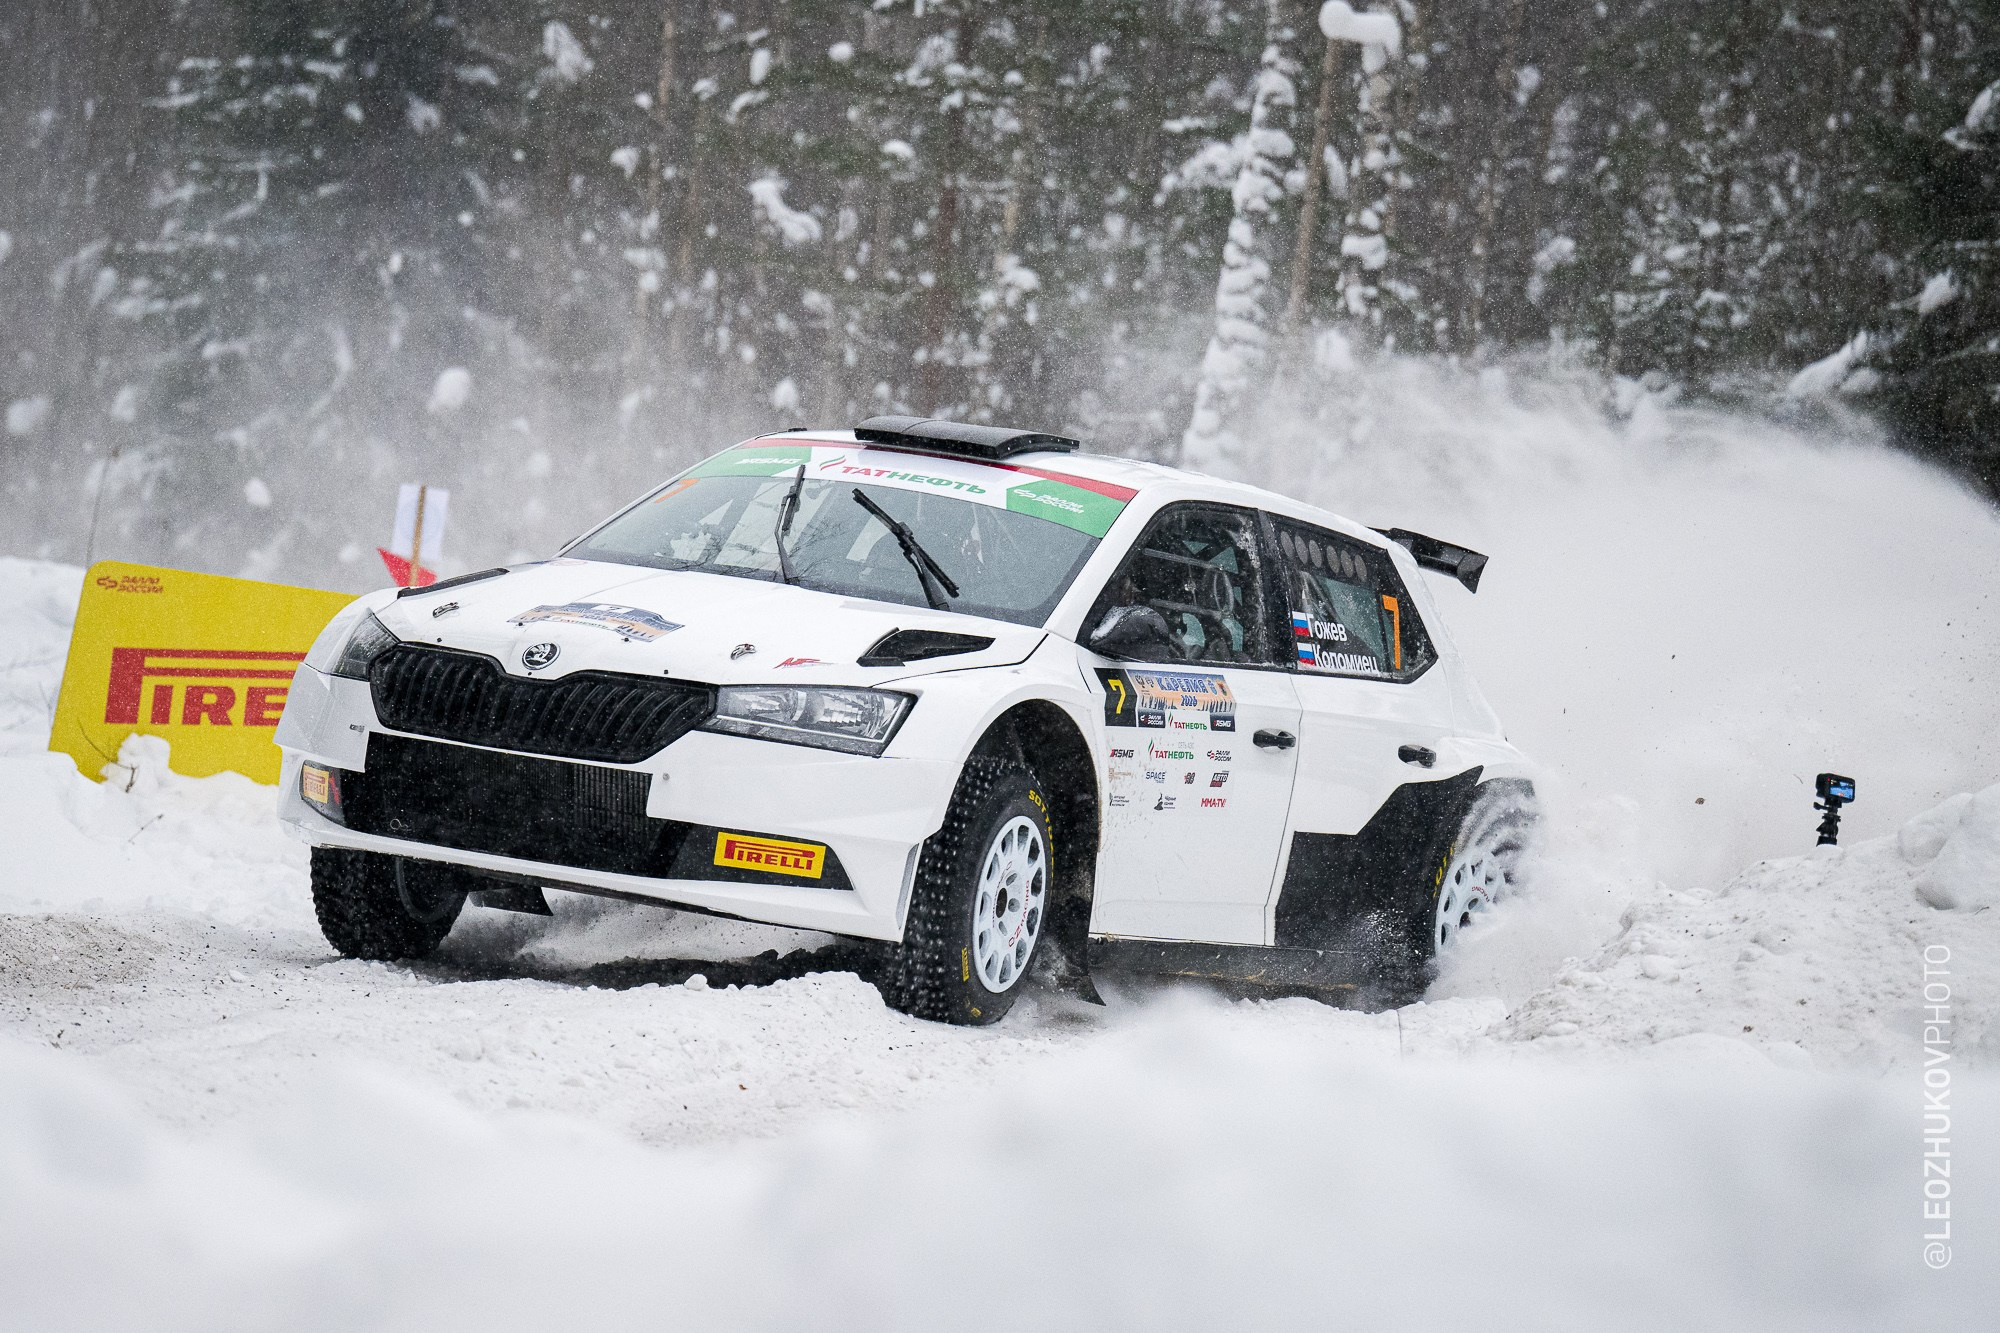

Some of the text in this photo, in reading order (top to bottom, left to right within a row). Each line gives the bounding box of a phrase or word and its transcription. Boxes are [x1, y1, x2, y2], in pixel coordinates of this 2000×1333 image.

[842, 466, 986, 494] ТАТНЕФТЬ
[1306, 613, 1347, 642] Гожев
[1382, 594, 1400, 670] 7
[1312, 643, 1380, 676] Коломиец
[1107, 679, 1126, 715] 7
[1156, 676, 1209, 693] КАРЕЛИЯ
[1180, 694, 1198, 707] 2026
[1174, 721, 1208, 731] ТАТНЕФТЬ
[1154, 750, 1194, 760] ТАТНЕФТЬ
[1145, 771, 1166, 780] SPACE
[724, 839, 816, 870] PIRELLI
